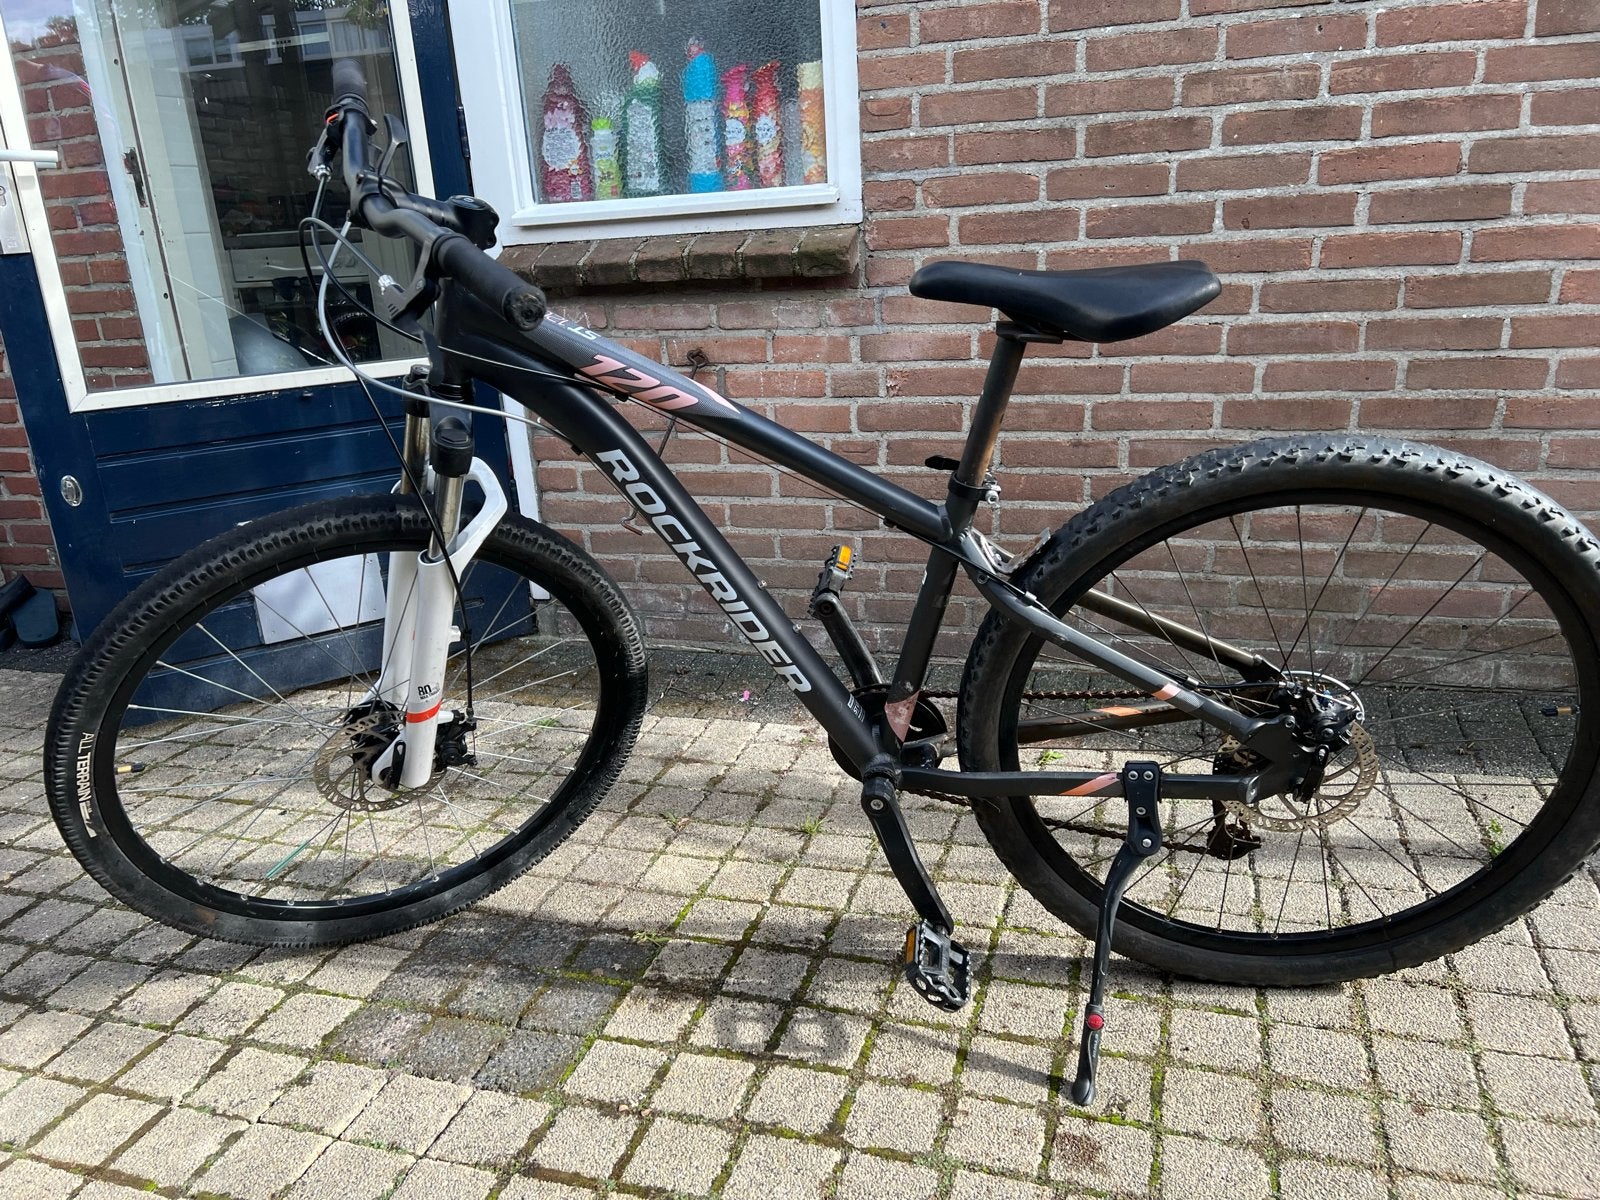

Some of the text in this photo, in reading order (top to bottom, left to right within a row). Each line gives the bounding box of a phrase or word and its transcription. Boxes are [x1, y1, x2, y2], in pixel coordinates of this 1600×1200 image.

[578, 354, 699, 411] 120
[596, 449, 812, 693] ROCKRIDER
[78, 732, 95, 754] ALL
[76, 752, 92, 802] TERRAIN
